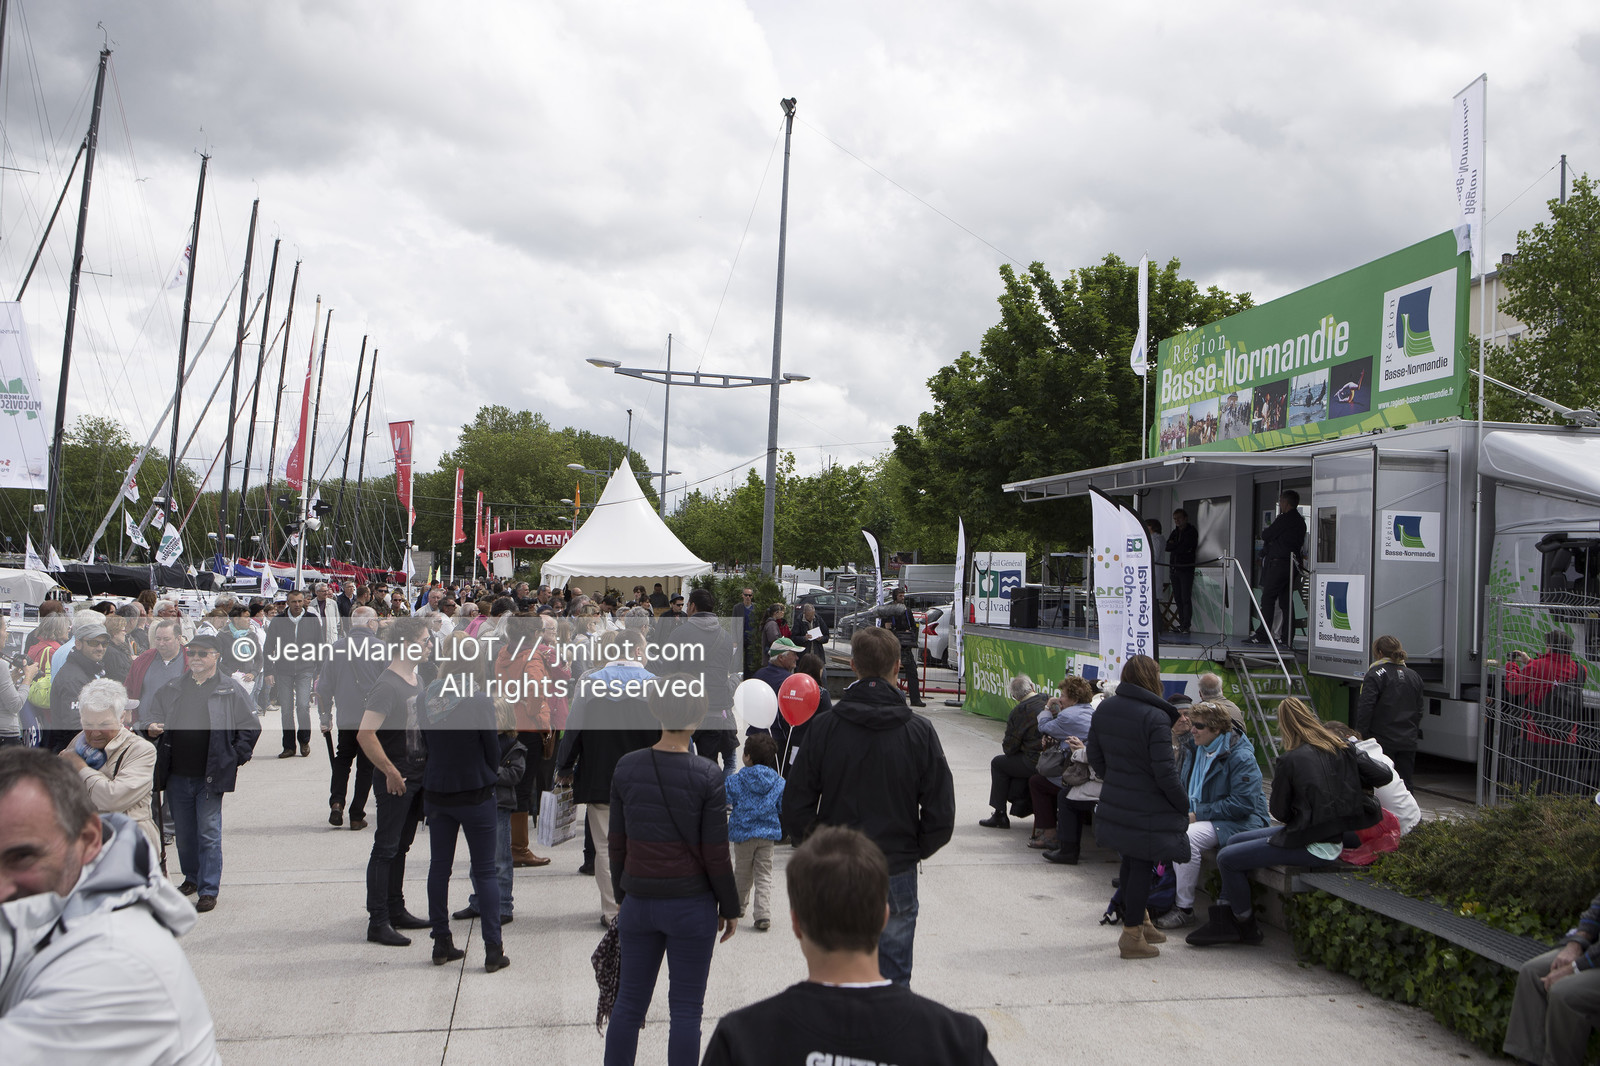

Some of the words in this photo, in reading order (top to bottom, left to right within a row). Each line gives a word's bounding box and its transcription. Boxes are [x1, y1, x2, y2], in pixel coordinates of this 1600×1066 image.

[1385, 299, 1396, 364] Région
[1161, 315, 1350, 405] Basse-Normandie
[1172, 334, 1226, 365] Région
[1384, 356, 1448, 381] Basse-Normandie
[1377, 387, 1454, 410] www.region-basse-normandie.fr
[524, 533, 562, 545] CAEN
[1385, 515, 1393, 547] Région
[979, 559, 1000, 567] Coseil
[1000, 559, 1023, 567] Général
[1318, 631, 1360, 645] Basse-Normandie
